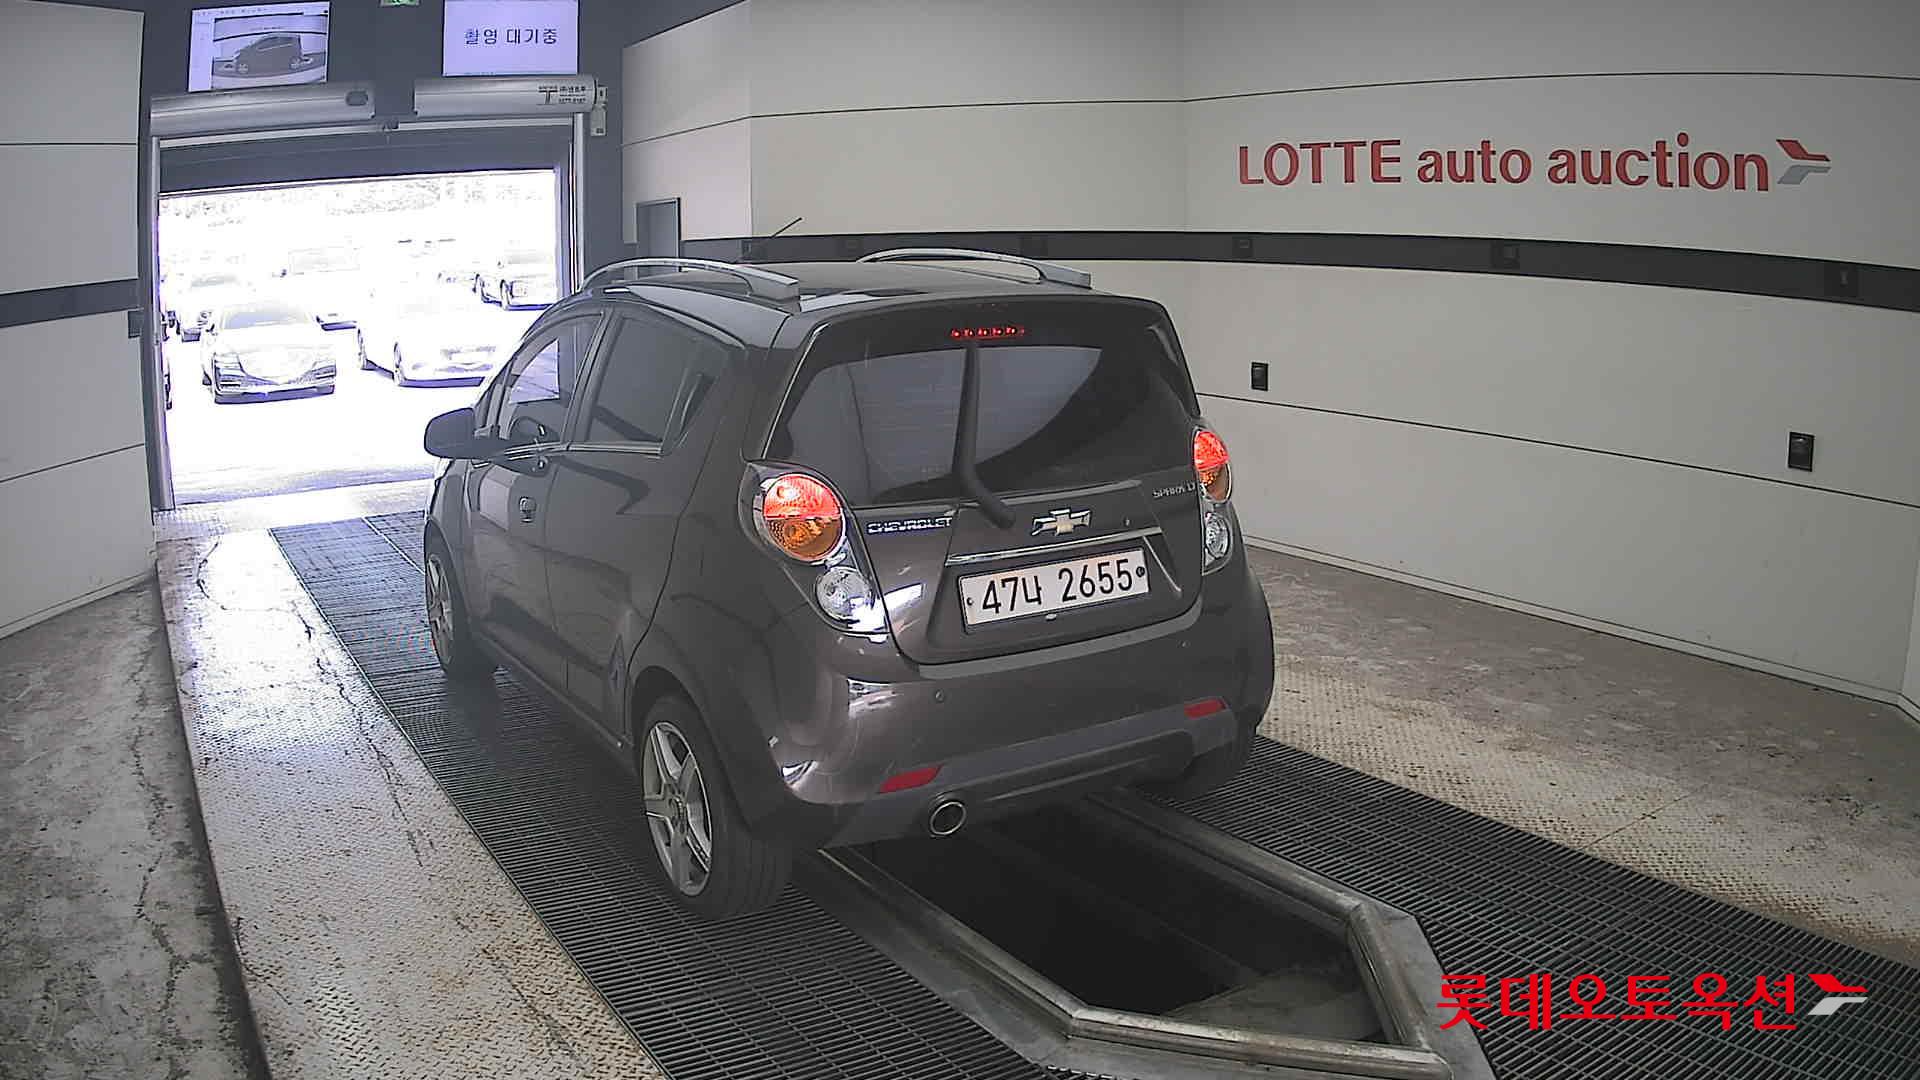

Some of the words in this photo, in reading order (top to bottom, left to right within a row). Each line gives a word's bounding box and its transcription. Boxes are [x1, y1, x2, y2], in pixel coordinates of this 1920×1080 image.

[506, 28, 557, 45] 대기중
[1239, 139, 1401, 186] LOTTE
[1416, 139, 1532, 184] auto
[1547, 132, 1770, 191] auction
[867, 517, 953, 534] CHEVROLET
[982, 572, 1042, 615] 47나
[1057, 558, 1133, 603] 2655
